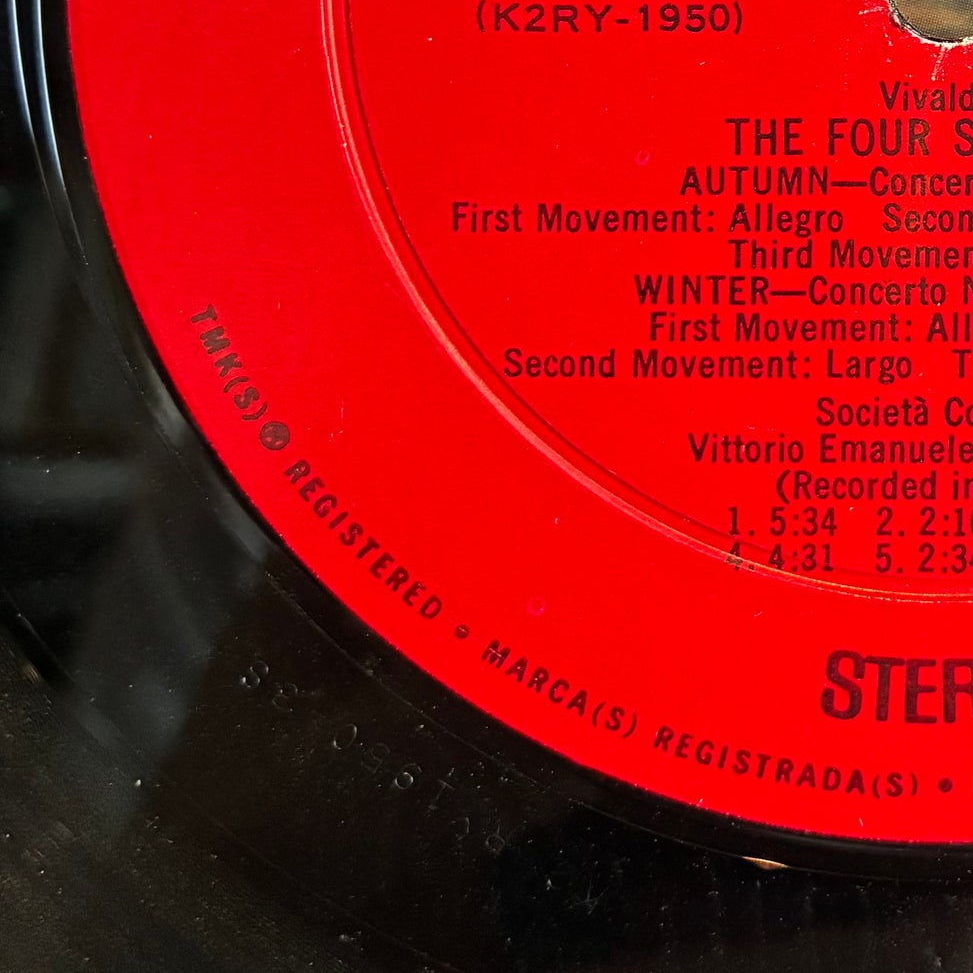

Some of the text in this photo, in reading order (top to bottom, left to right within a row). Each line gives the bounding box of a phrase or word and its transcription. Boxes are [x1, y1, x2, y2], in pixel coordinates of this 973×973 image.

[475, 0, 743, 36] (K2RY-1950)
[724, 117, 804, 157] THE
[827, 117, 931, 158] FOUR
[451, 201, 523, 234] First
[536, 202, 715, 234] Movement:
[727, 202, 844, 239] Allegro
[727, 238, 813, 270] Third
[649, 310, 721, 343] First
[734, 312, 913, 343] Movement:
[503, 347, 616, 379] Second
[632, 348, 811, 380] Movement:
[826, 348, 912, 386] Largo
[815, 395, 929, 428] Società
[687, 432, 805, 464] Vittorio
[775, 468, 937, 505] (Recorded
[727, 505, 755, 537] 1.
[769, 506, 838, 537] 5:34
[875, 505, 905, 538] 2.
[725, 540, 755, 572] 4.
[767, 542, 835, 573] 4:31
[875, 542, 904, 574] 5.
[283, 459, 443, 620] REGISTERED
[480, 639, 638, 739] MARCA(S)
[652, 725, 919, 800] REGISTRADA(S)
